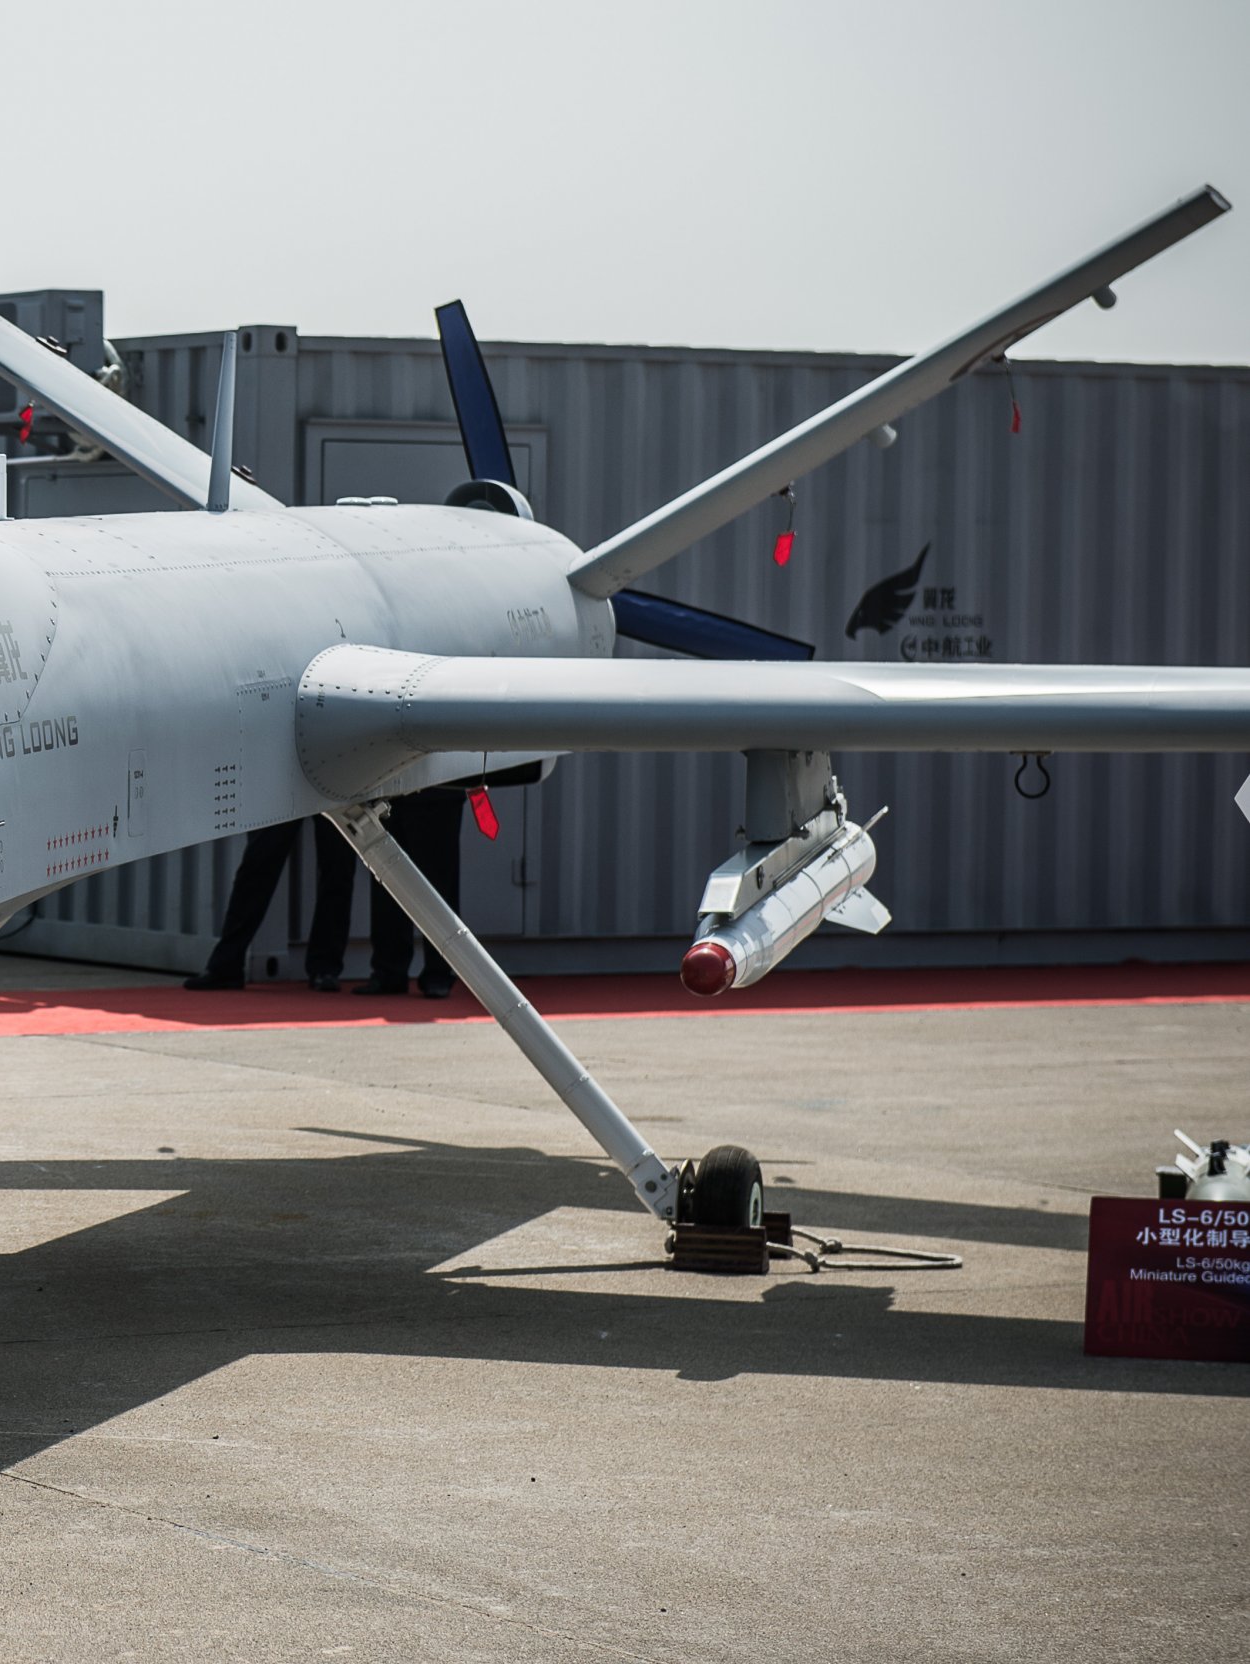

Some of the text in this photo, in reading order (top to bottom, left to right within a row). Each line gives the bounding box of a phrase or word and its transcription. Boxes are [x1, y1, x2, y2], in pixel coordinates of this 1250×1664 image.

[921, 634, 992, 657] 中航工业
[20, 715, 79, 754] LOONG
[1159, 1207, 1250, 1227] LS-6/50
[1136, 1227, 1250, 1248] 小型化制导
[1130, 1268, 1197, 1281] Miniature
[1176, 1257, 1250, 1273] LS-6/50kg
